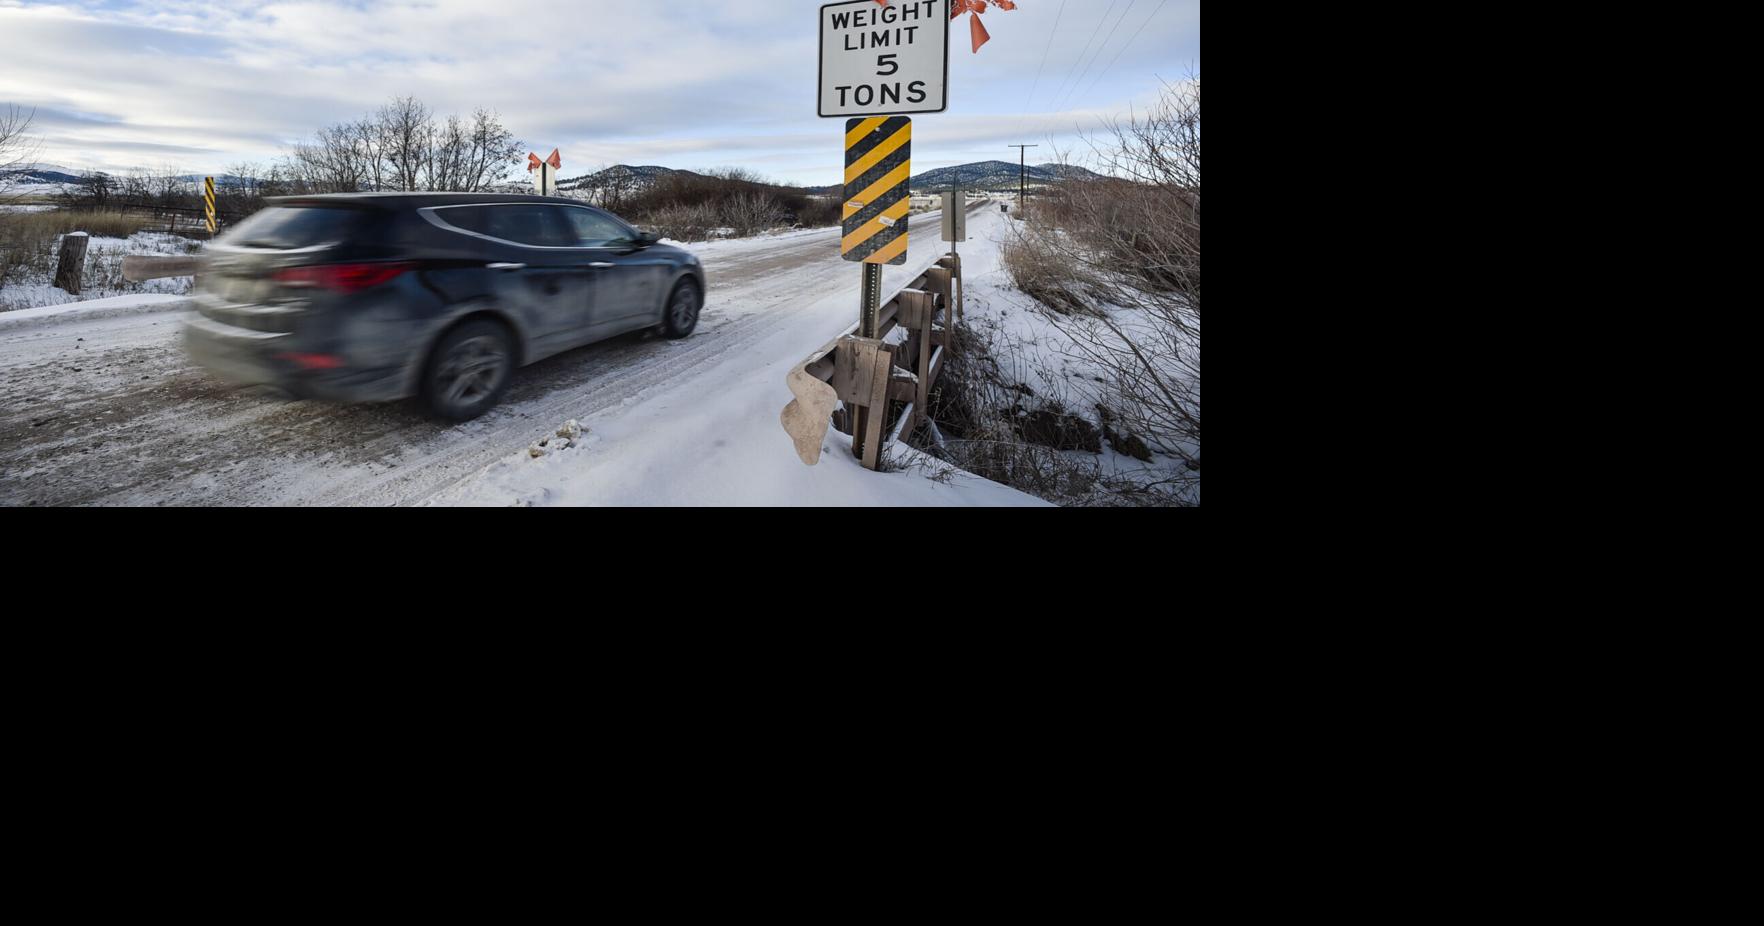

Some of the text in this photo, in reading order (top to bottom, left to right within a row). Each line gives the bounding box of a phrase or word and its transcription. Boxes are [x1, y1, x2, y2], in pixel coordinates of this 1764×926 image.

[832, 0, 937, 30] WEIGHT
[844, 26, 919, 51] LIMIT
[876, 53, 899, 76] 5
[835, 80, 927, 106] TONS
